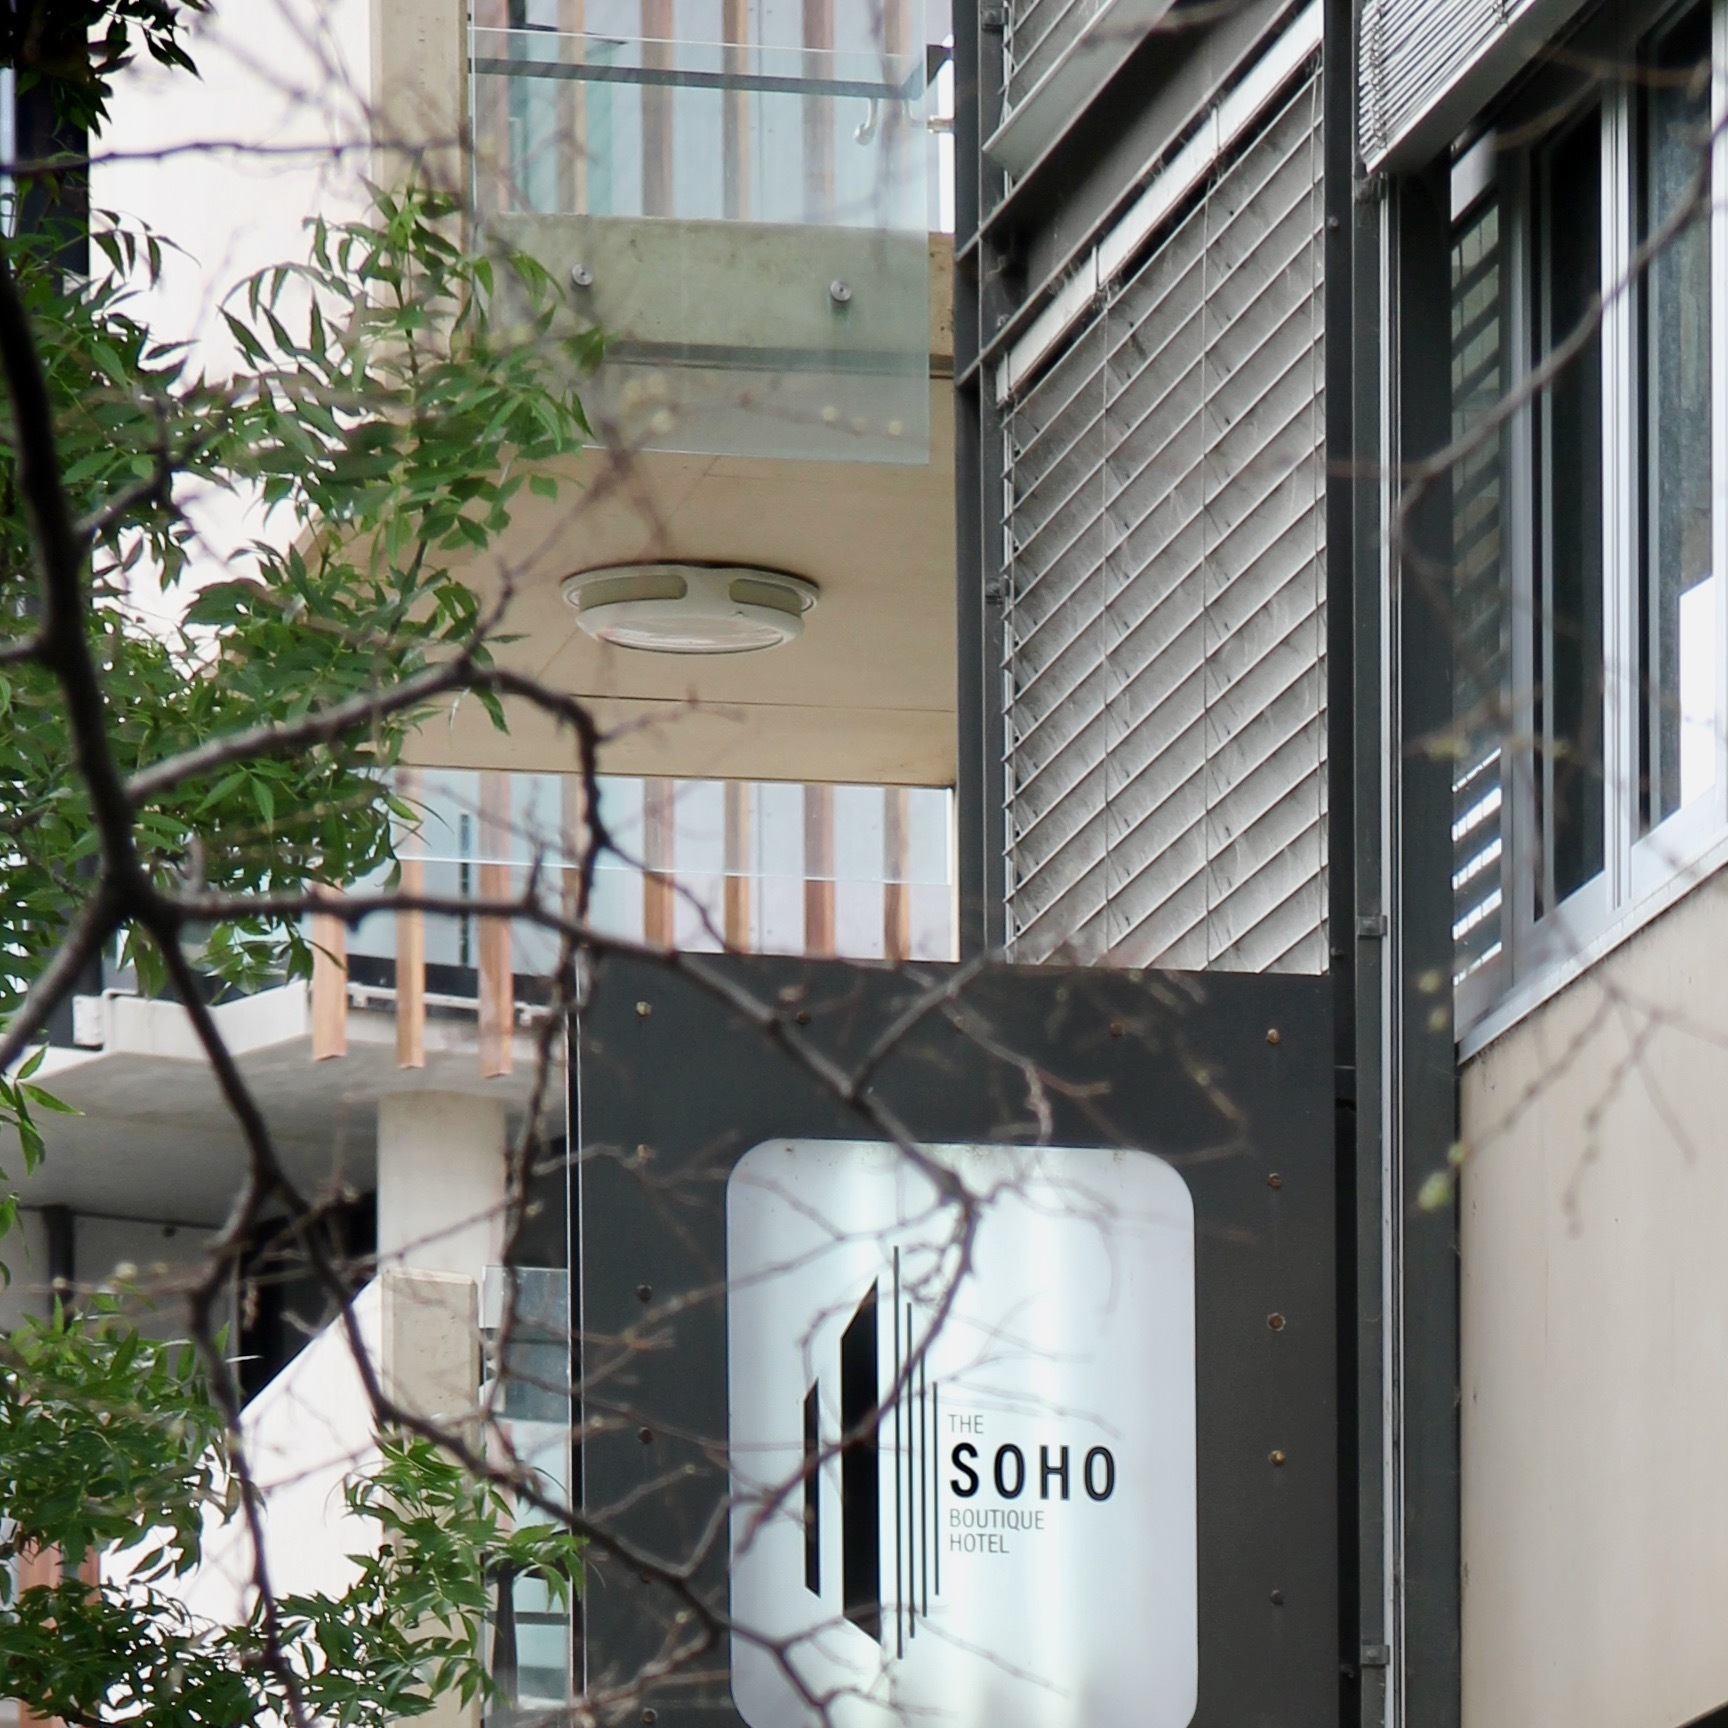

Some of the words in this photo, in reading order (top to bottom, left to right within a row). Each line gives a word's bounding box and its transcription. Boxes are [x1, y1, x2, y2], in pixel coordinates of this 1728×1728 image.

[948, 1413, 985, 1435] THE
[948, 1441, 1117, 1502] SOHO
[949, 1508, 1045, 1531] BOUTIQUE
[949, 1533, 1010, 1554] HOTEL
